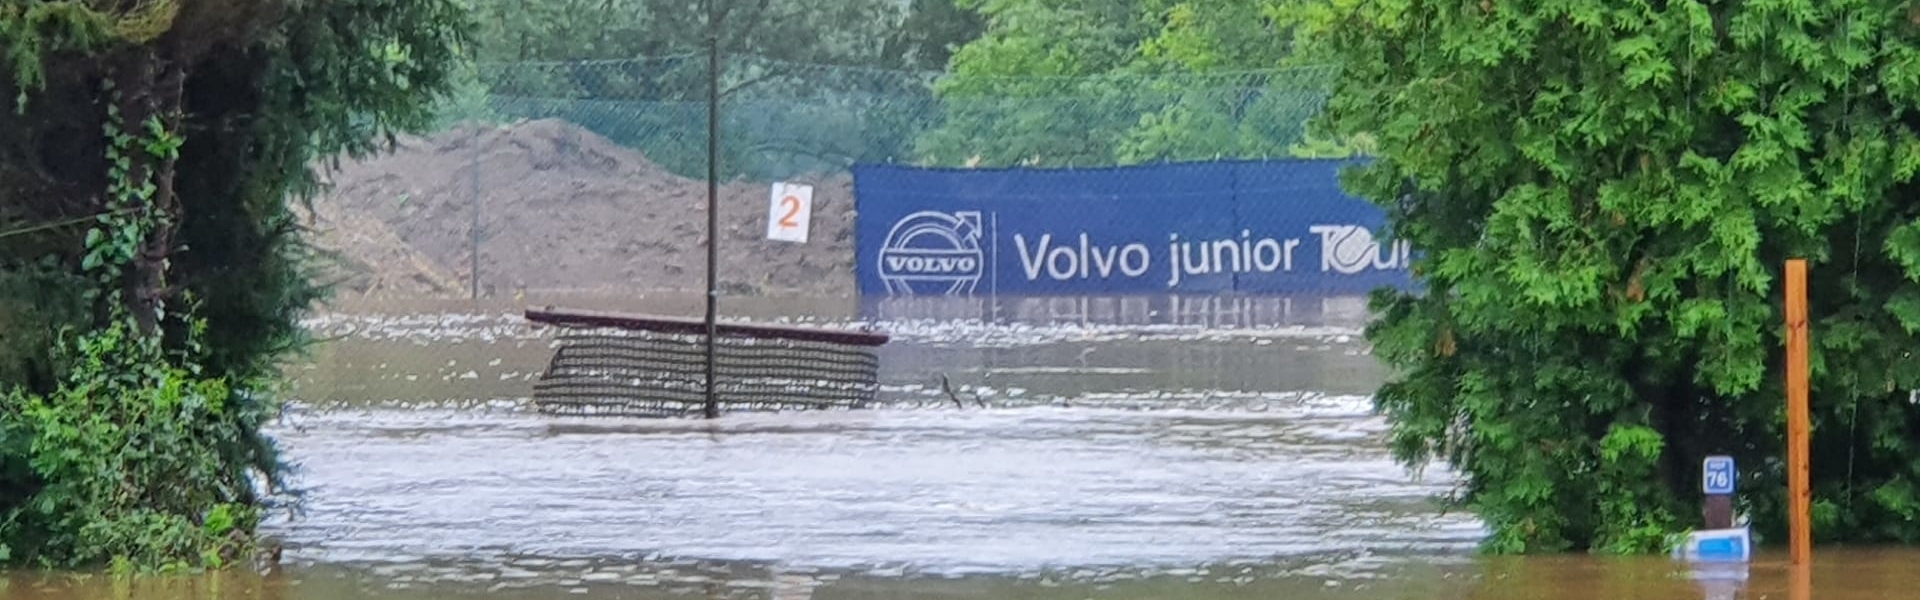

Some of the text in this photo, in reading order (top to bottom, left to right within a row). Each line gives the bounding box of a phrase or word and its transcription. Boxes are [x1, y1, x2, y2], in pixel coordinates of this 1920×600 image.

[778, 195, 800, 227] 2
[885, 256, 976, 273] VOLVO
[1014, 232, 1150, 281] Volvo
[1168, 229, 1300, 287] junior
[1707, 471, 1728, 488] 76
